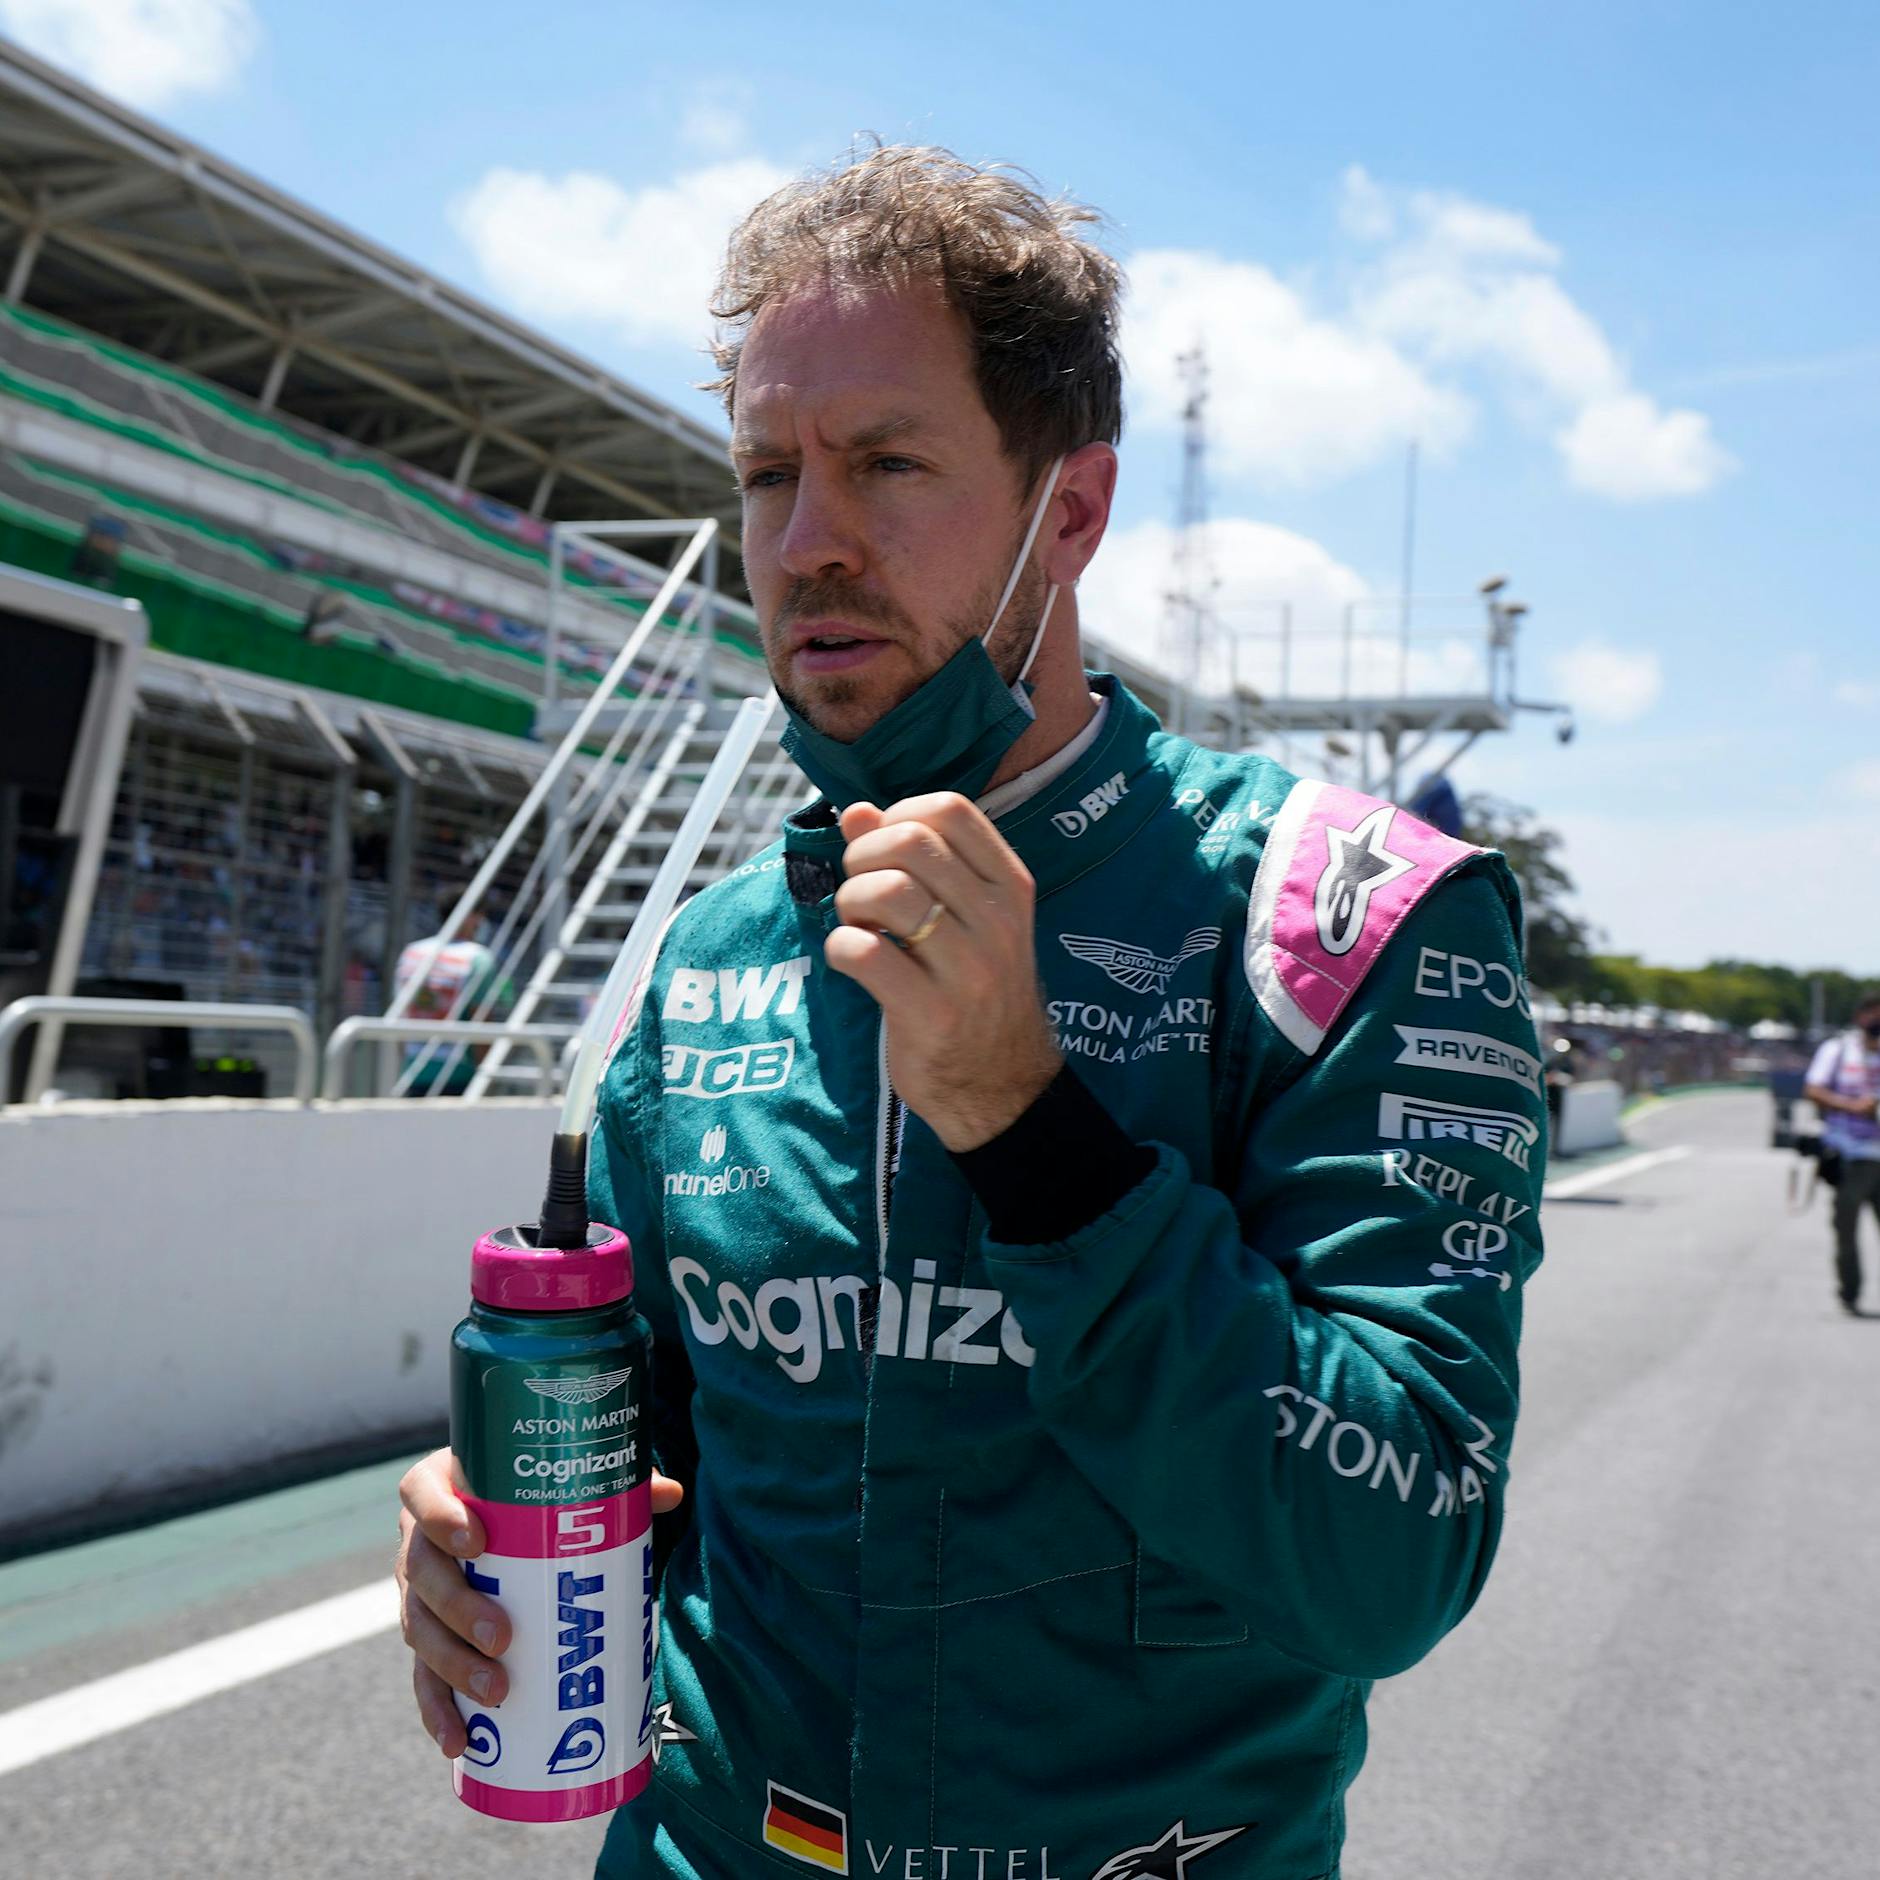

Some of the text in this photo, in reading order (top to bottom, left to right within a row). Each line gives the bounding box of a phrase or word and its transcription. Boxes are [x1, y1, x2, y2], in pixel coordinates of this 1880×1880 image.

[1079, 771, 1130, 822] BWT
[1114, 953, 1156, 971] ASTON
[661, 955, 812, 1026] BWT
[1047, 999, 1134, 1040] STON
[1184, 1032, 1212, 1054] TE
[664, 1046, 789, 1092] JCB
[663, 1163, 771, 1198] ntinelOne
[1441, 1219, 1509, 1263] GP
[511, 1403, 640, 1436] ASTON MARTIN
[512, 1439, 638, 1485] Cognizant
[1262, 1384, 1421, 1503] STON
[514, 1487, 578, 1501] FORMULA
[612, 1473, 637, 1490] TEAM
[556, 1505, 606, 1552] 5
[556, 1570, 606, 1712] BWT
[864, 1838, 1061, 1880] VETTEL
